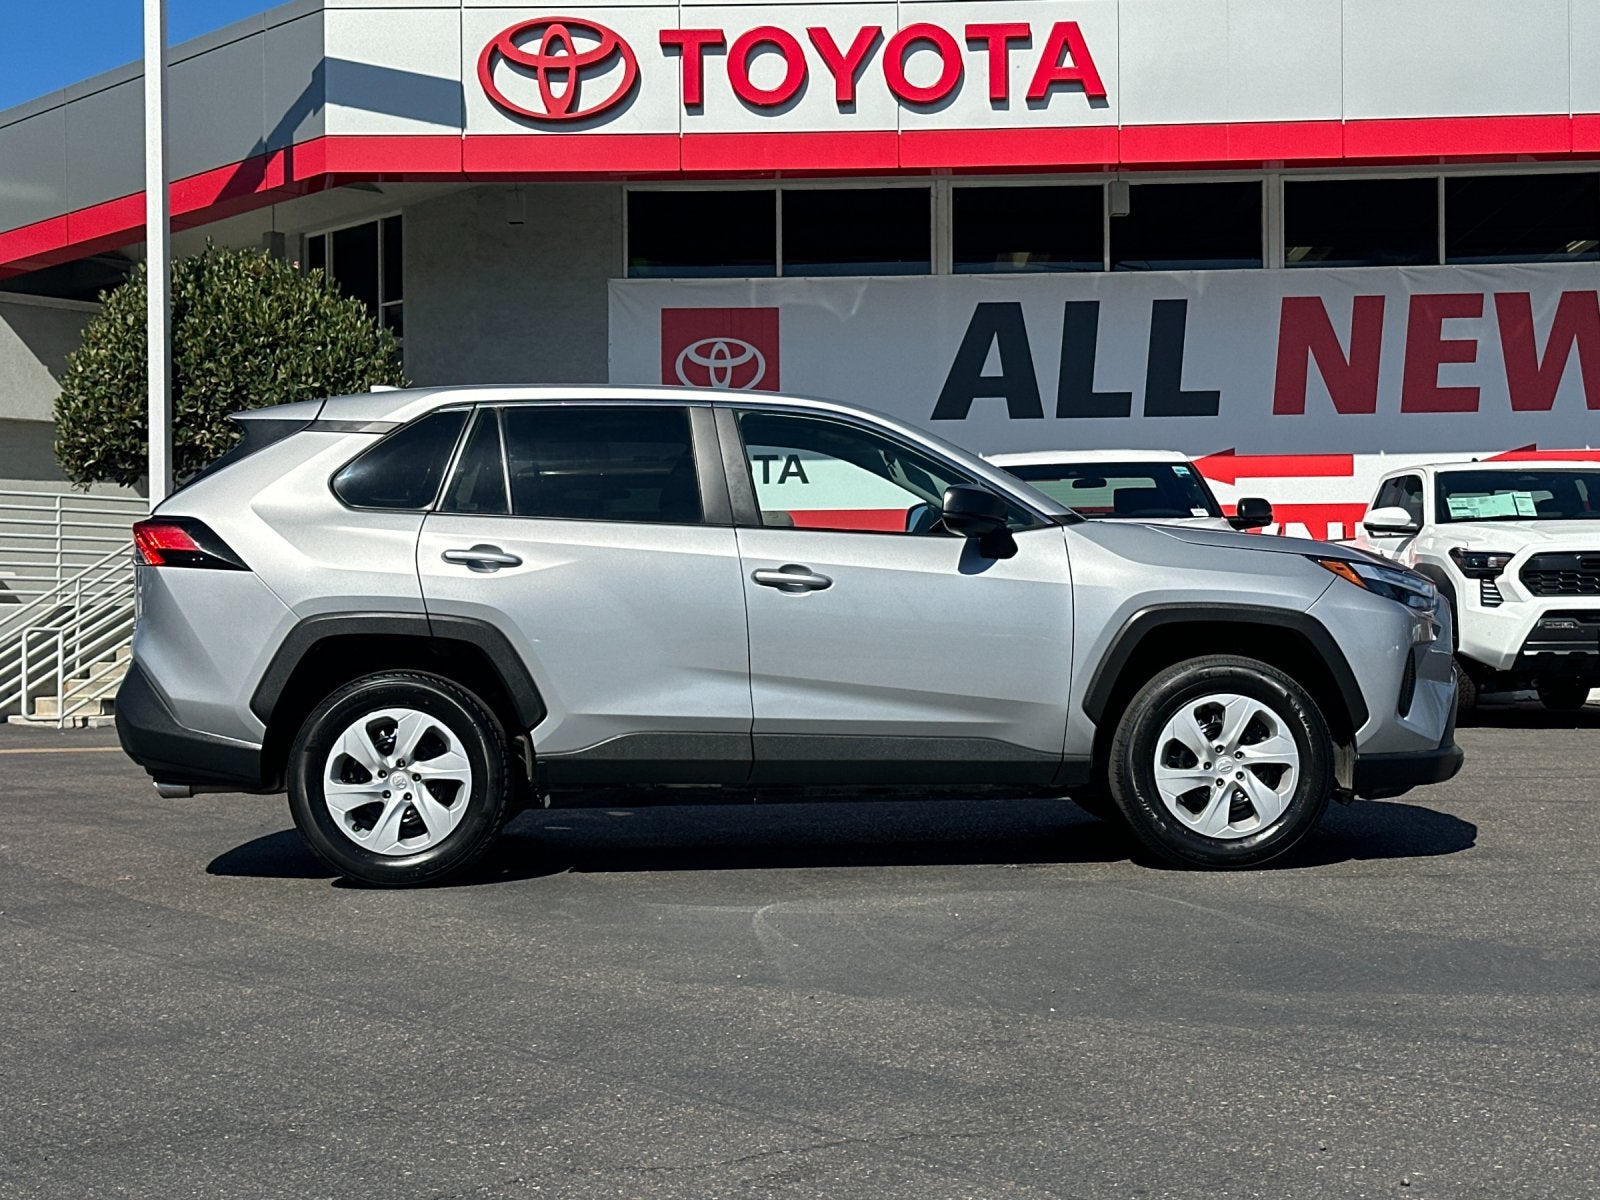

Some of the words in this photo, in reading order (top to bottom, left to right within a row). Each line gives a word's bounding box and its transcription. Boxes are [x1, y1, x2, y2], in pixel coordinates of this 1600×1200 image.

[659, 21, 1107, 106] TOYOTA
[930, 299, 1220, 420] ALL
[1273, 290, 1600, 415] NEW
[751, 454, 810, 484] TA
